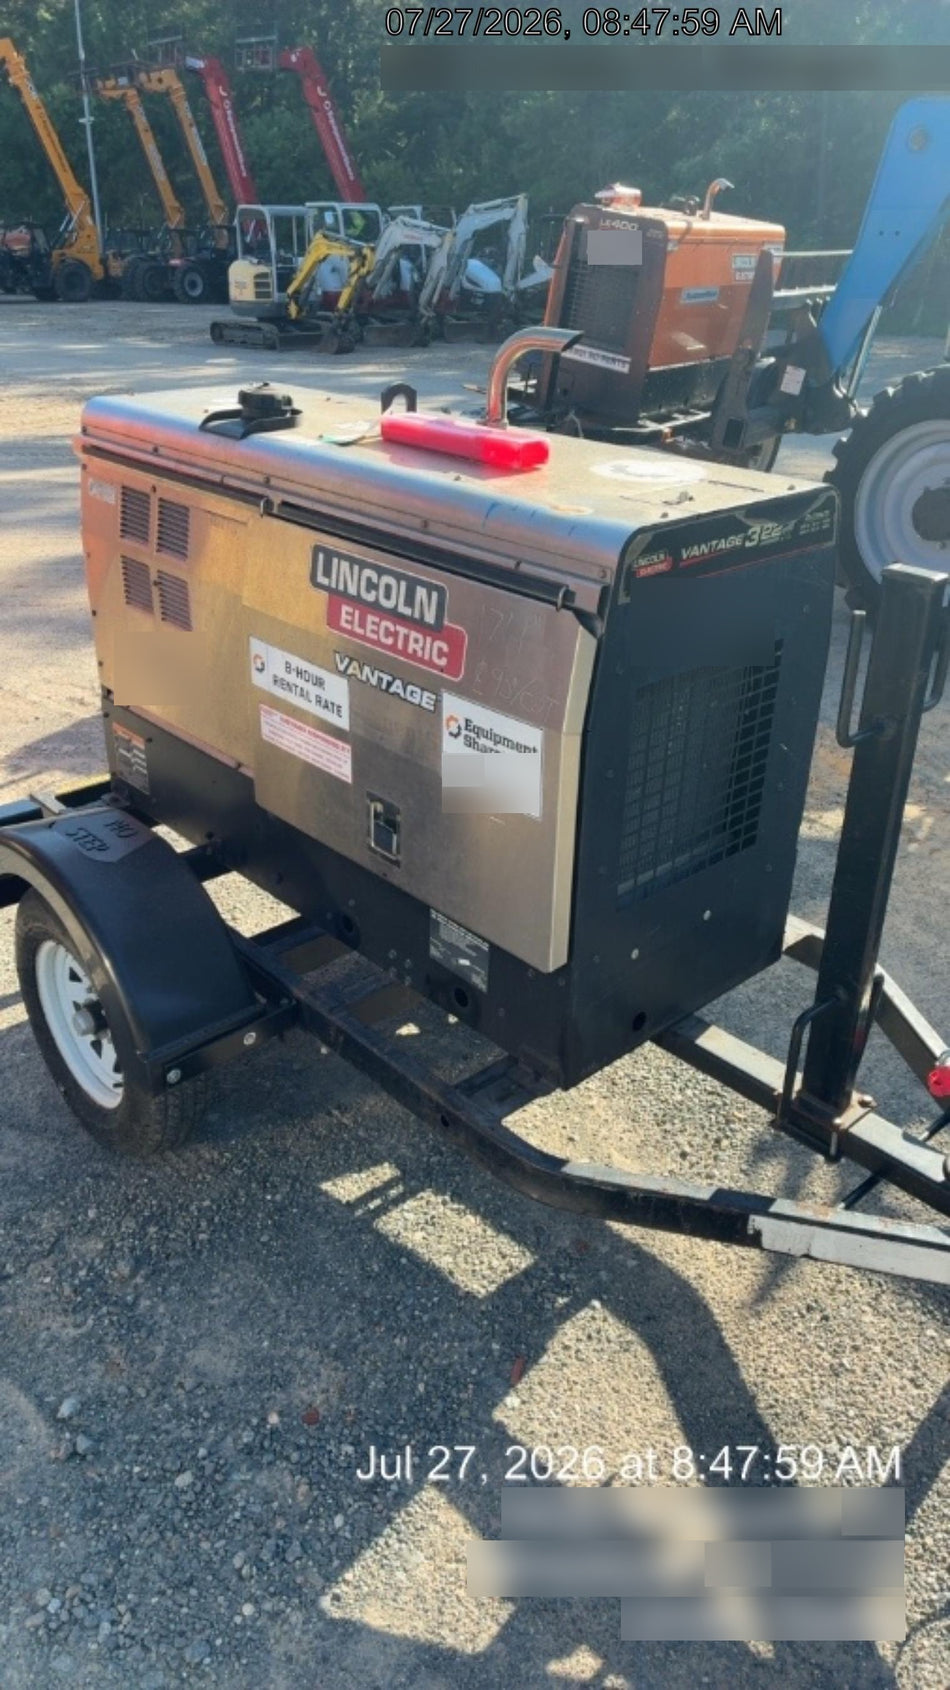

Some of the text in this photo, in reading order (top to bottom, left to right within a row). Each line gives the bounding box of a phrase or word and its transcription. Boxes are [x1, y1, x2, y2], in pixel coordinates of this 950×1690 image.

[681, 534, 743, 560] VANTAGE
[316, 551, 438, 625] LINCOLN
[339, 603, 449, 666] ELECTRIC
[272, 673, 313, 703] RENTAL
[285, 660, 325, 691] 8-HOUR
[334, 651, 437, 711] VANTAGE
[315, 694, 343, 718] RATE
[463, 717, 539, 754] Equipment
[463, 733, 505, 754] Shar
[65, 827, 110, 851] STEP
